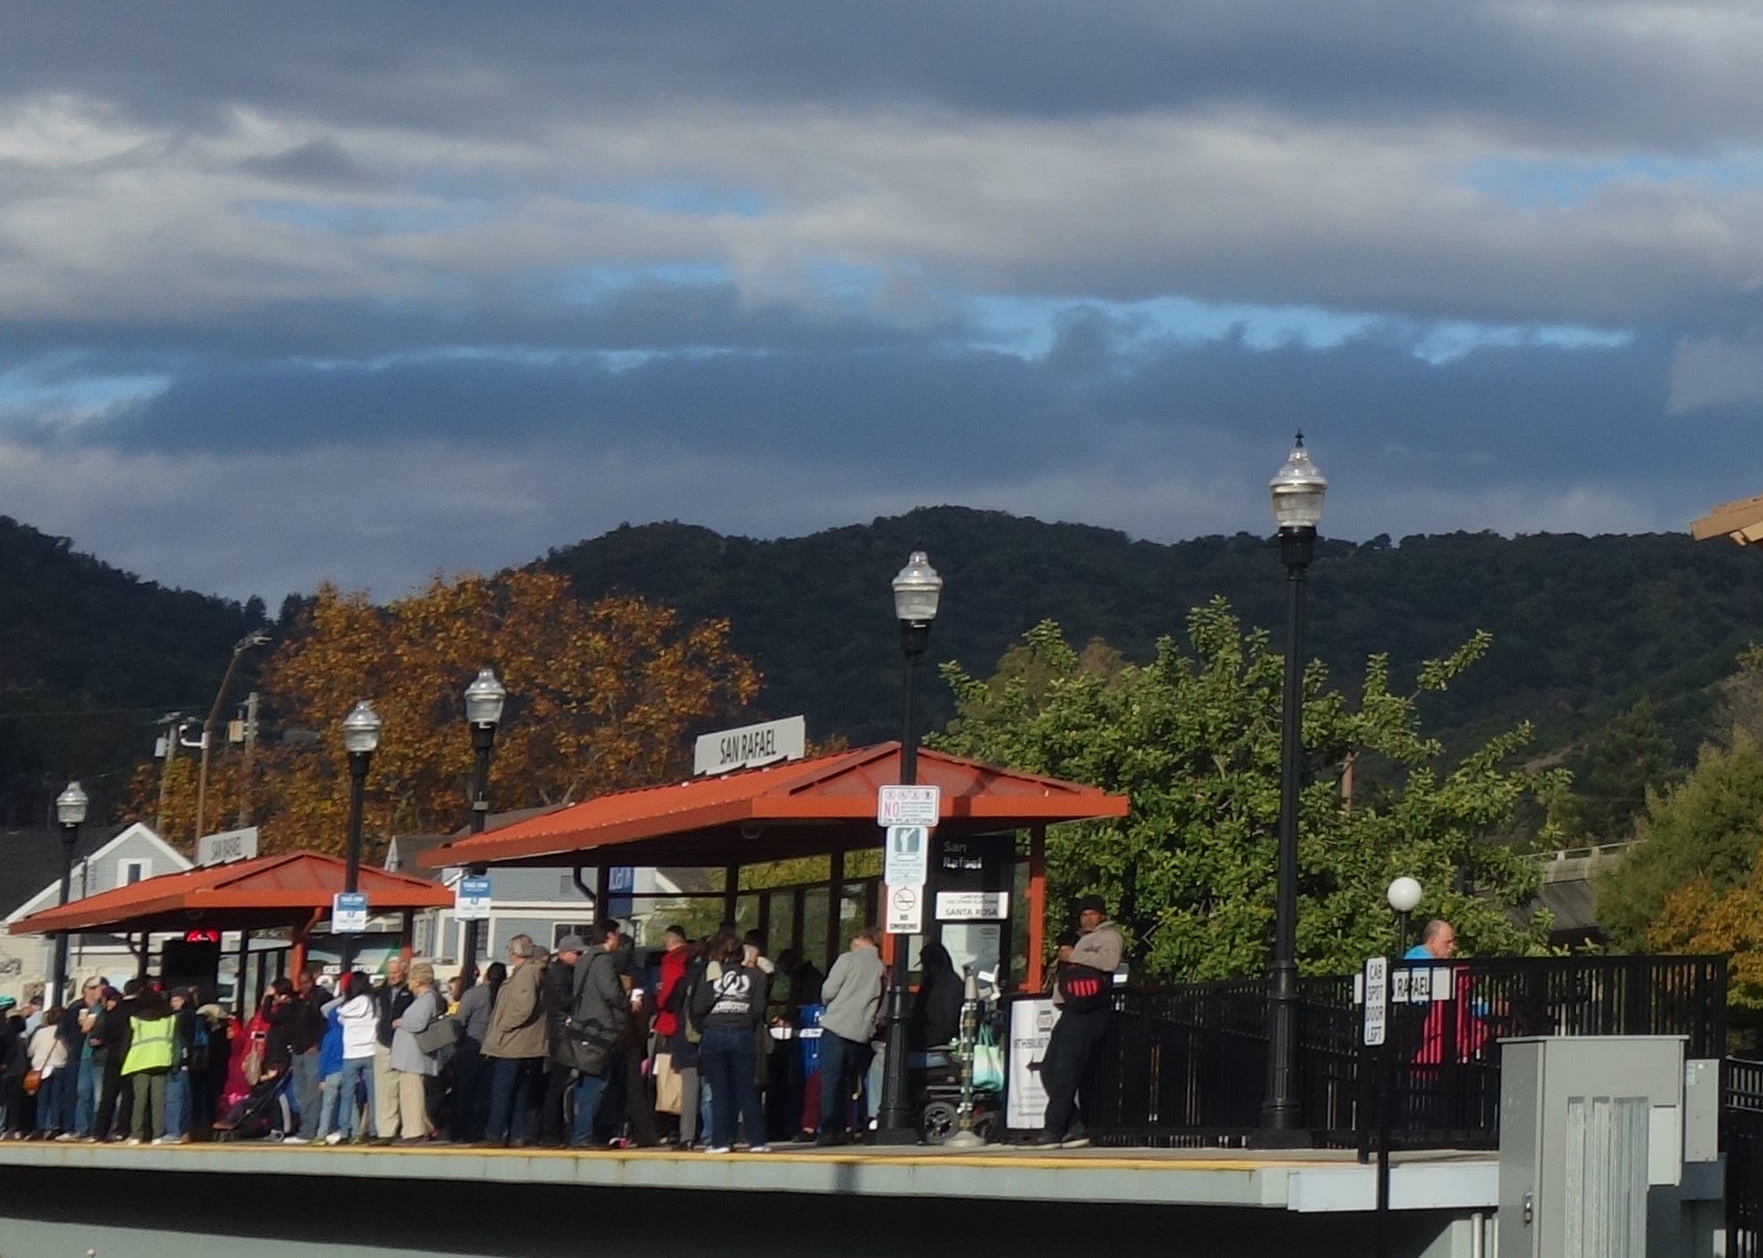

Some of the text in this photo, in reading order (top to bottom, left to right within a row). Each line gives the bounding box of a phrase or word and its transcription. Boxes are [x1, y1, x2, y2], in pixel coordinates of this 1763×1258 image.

[720, 729, 777, 764] SAN RAFAEL
[884, 802, 900, 817] NO
[943, 841, 966, 852] San
[943, 857, 982, 868] Rafael
[945, 908, 998, 916] SANTA ROSA
[1369, 964, 1383, 980] CAB
[1367, 984, 1384, 1001] SPOT
[1366, 1026, 1382, 1042] LEFT
